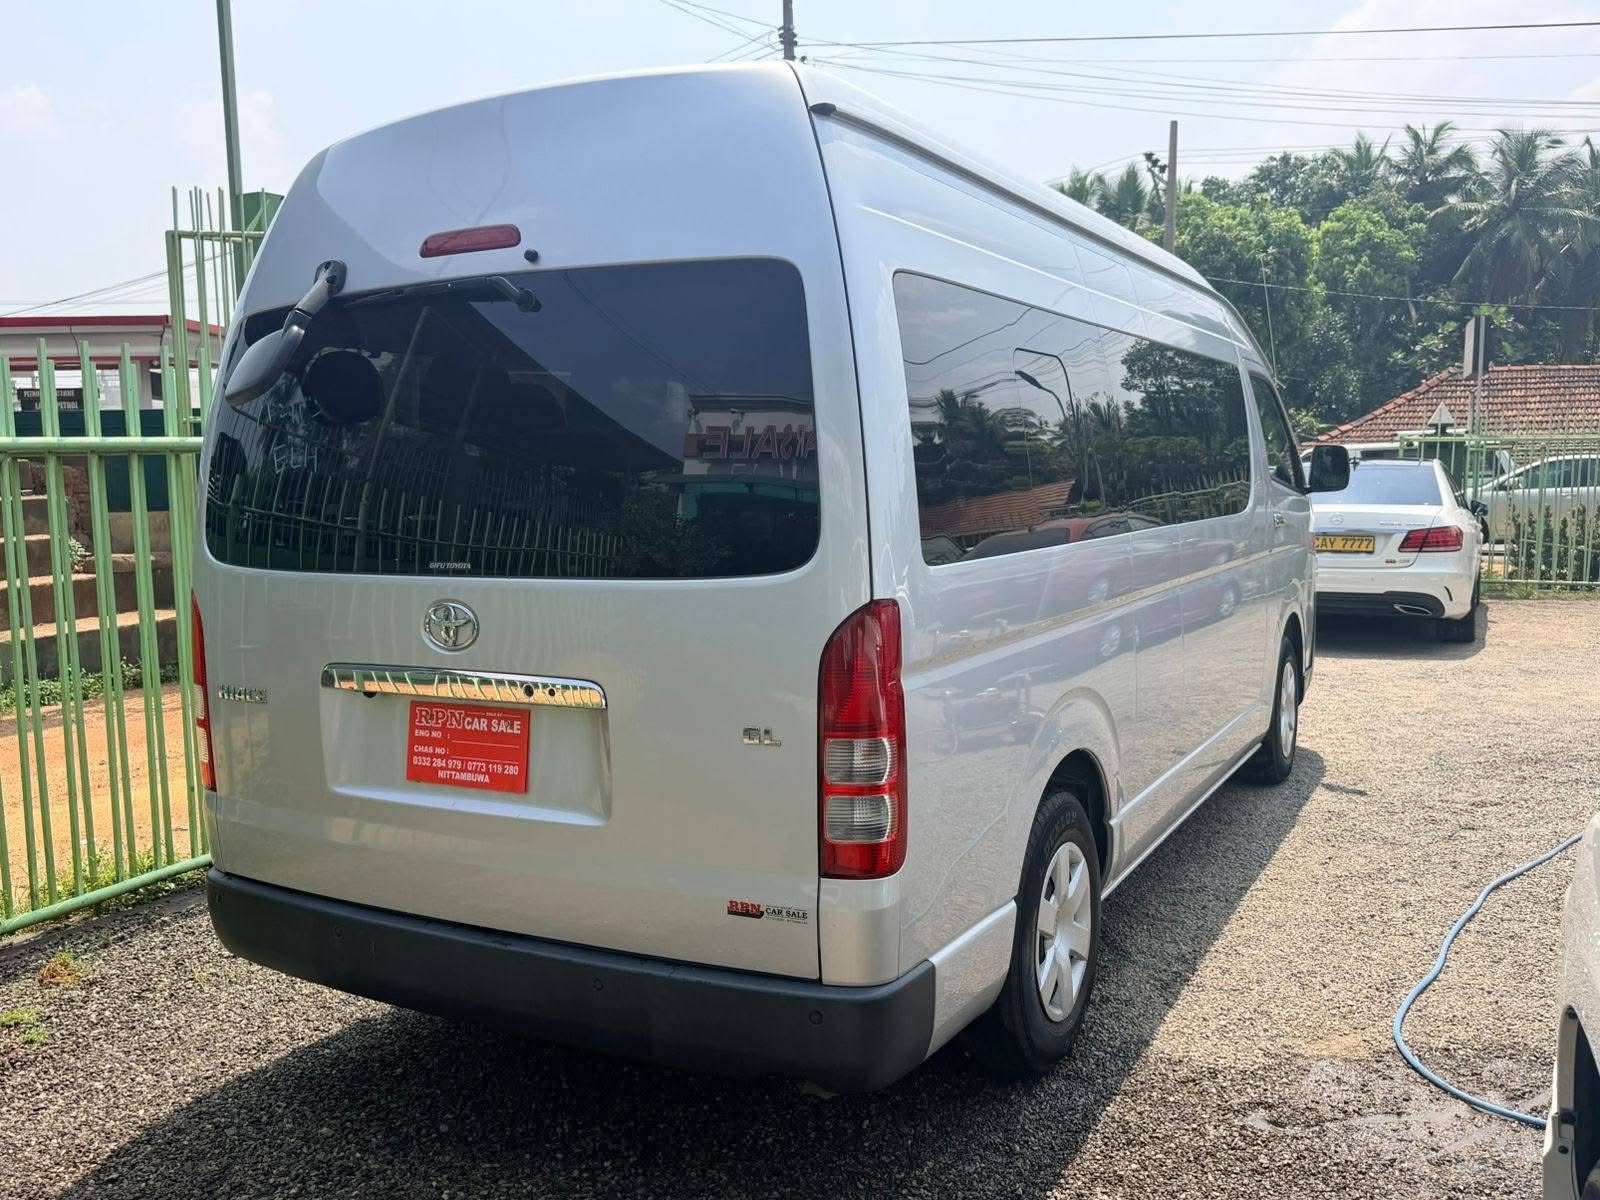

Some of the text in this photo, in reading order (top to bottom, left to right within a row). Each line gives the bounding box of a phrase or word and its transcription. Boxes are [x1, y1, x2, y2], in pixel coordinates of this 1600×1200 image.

[1341, 537, 1373, 549] 7777
[415, 707, 521, 735] RPN CAR SALE
[413, 745, 434, 755] CHAS
[412, 755, 431, 767] 0332
[432, 757, 447, 768] 284
[447, 759, 462, 770] 979
[467, 761, 487, 772] 0773
[489, 763, 502, 774] 119
[504, 765, 519, 776] 280
[438, 770, 490, 783] NITTAMBUWA
[765, 908, 783, 916] CAR
[786, 910, 808, 919] SALE
